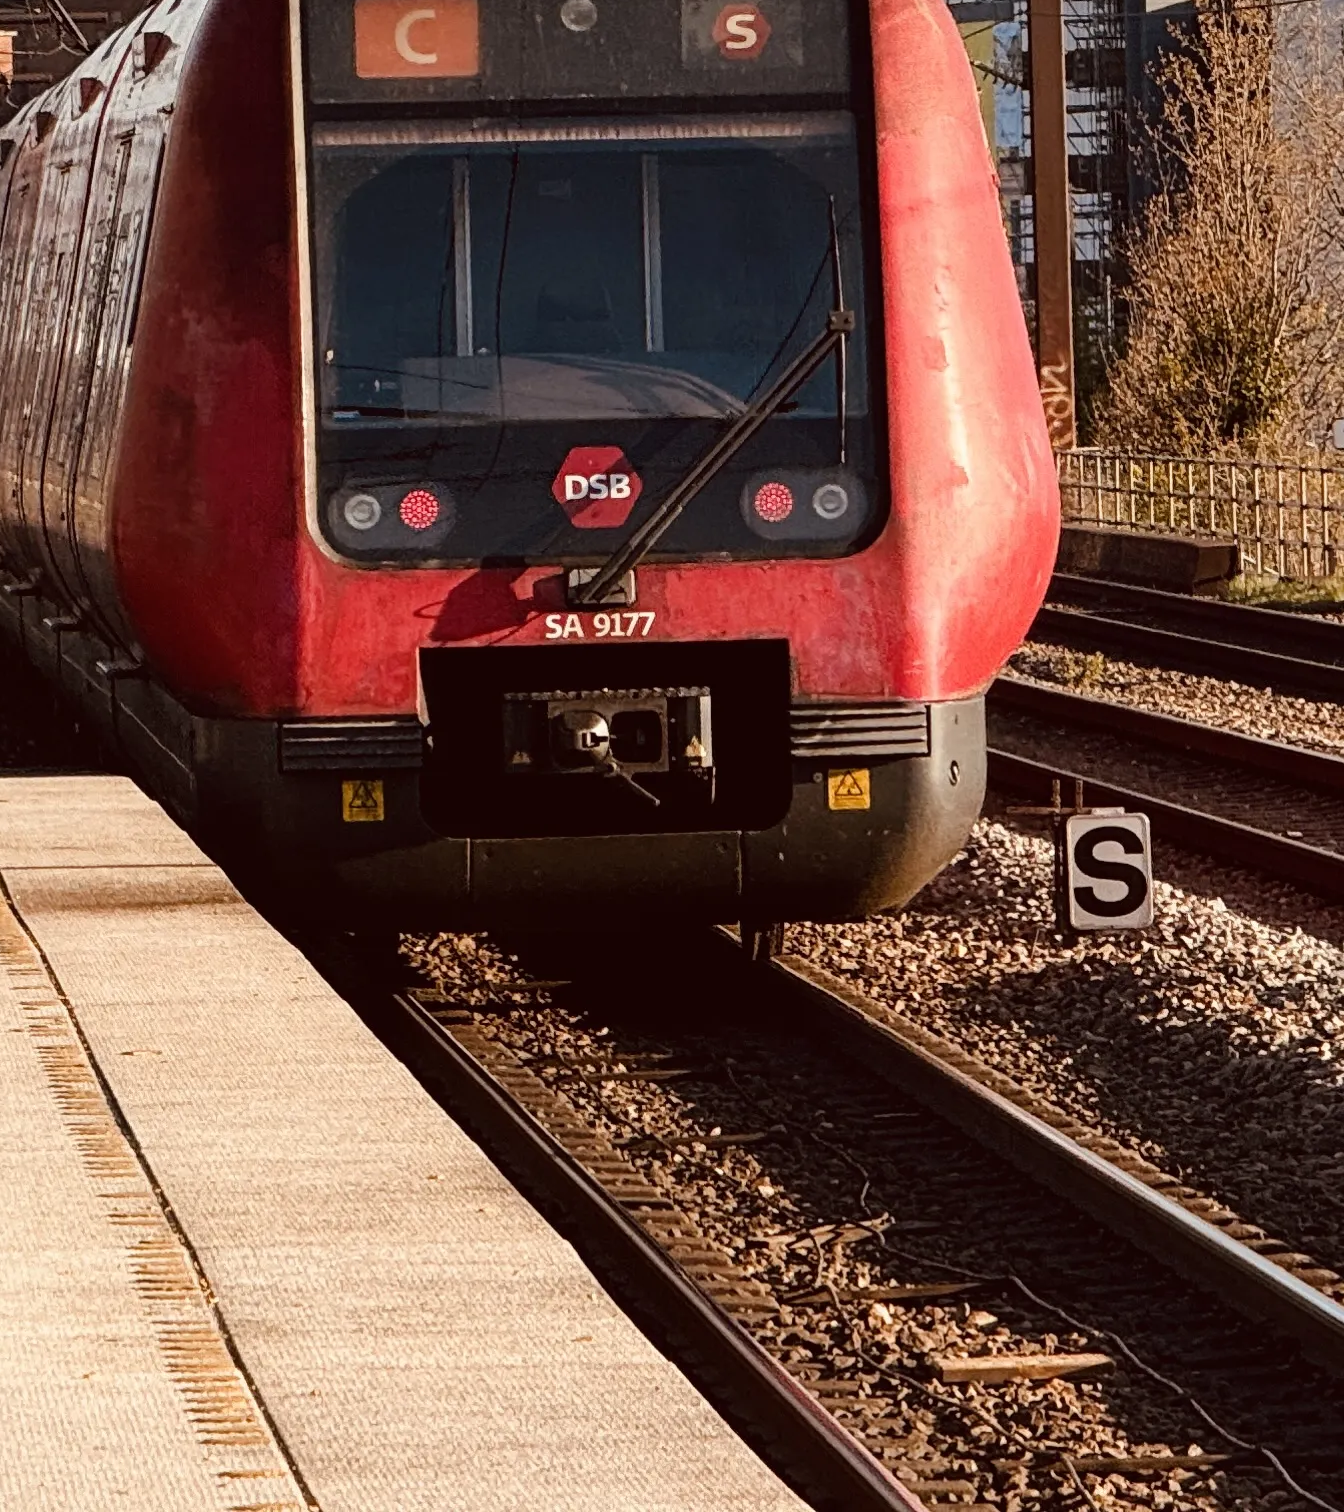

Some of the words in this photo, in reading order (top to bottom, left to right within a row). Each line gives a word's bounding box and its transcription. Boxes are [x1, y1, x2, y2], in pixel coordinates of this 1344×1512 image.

[394, 8, 438, 65] C
[725, 13, 758, 50] S
[564, 473, 632, 501] DSB
[545, 613, 585, 639] SA
[593, 611, 656, 638] 9177
[1073, 825, 1148, 918] S
